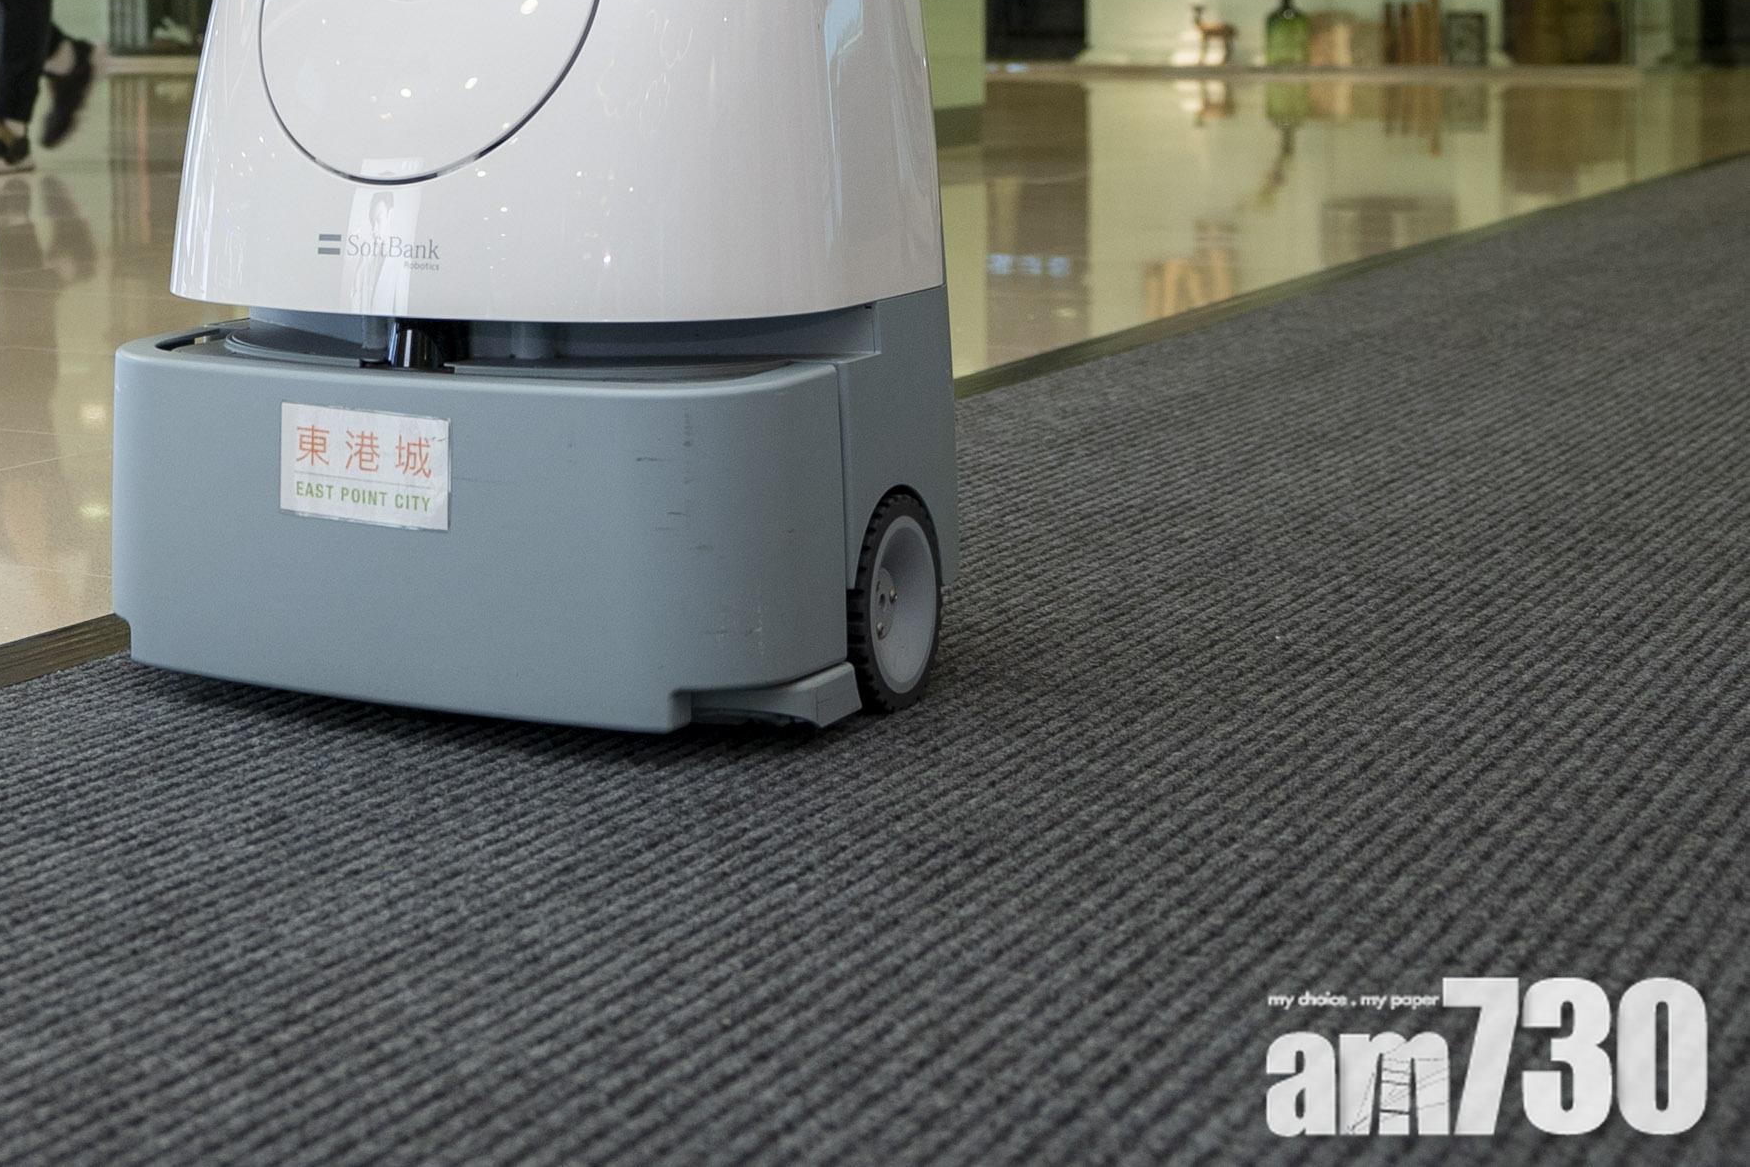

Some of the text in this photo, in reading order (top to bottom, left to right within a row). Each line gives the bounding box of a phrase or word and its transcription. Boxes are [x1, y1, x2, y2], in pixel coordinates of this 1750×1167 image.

[346, 234, 440, 261] SoftBank
[404, 260, 440, 271] Robotics
[295, 424, 433, 479] 東港城
[296, 481, 432, 513] EAST POINT CITY
